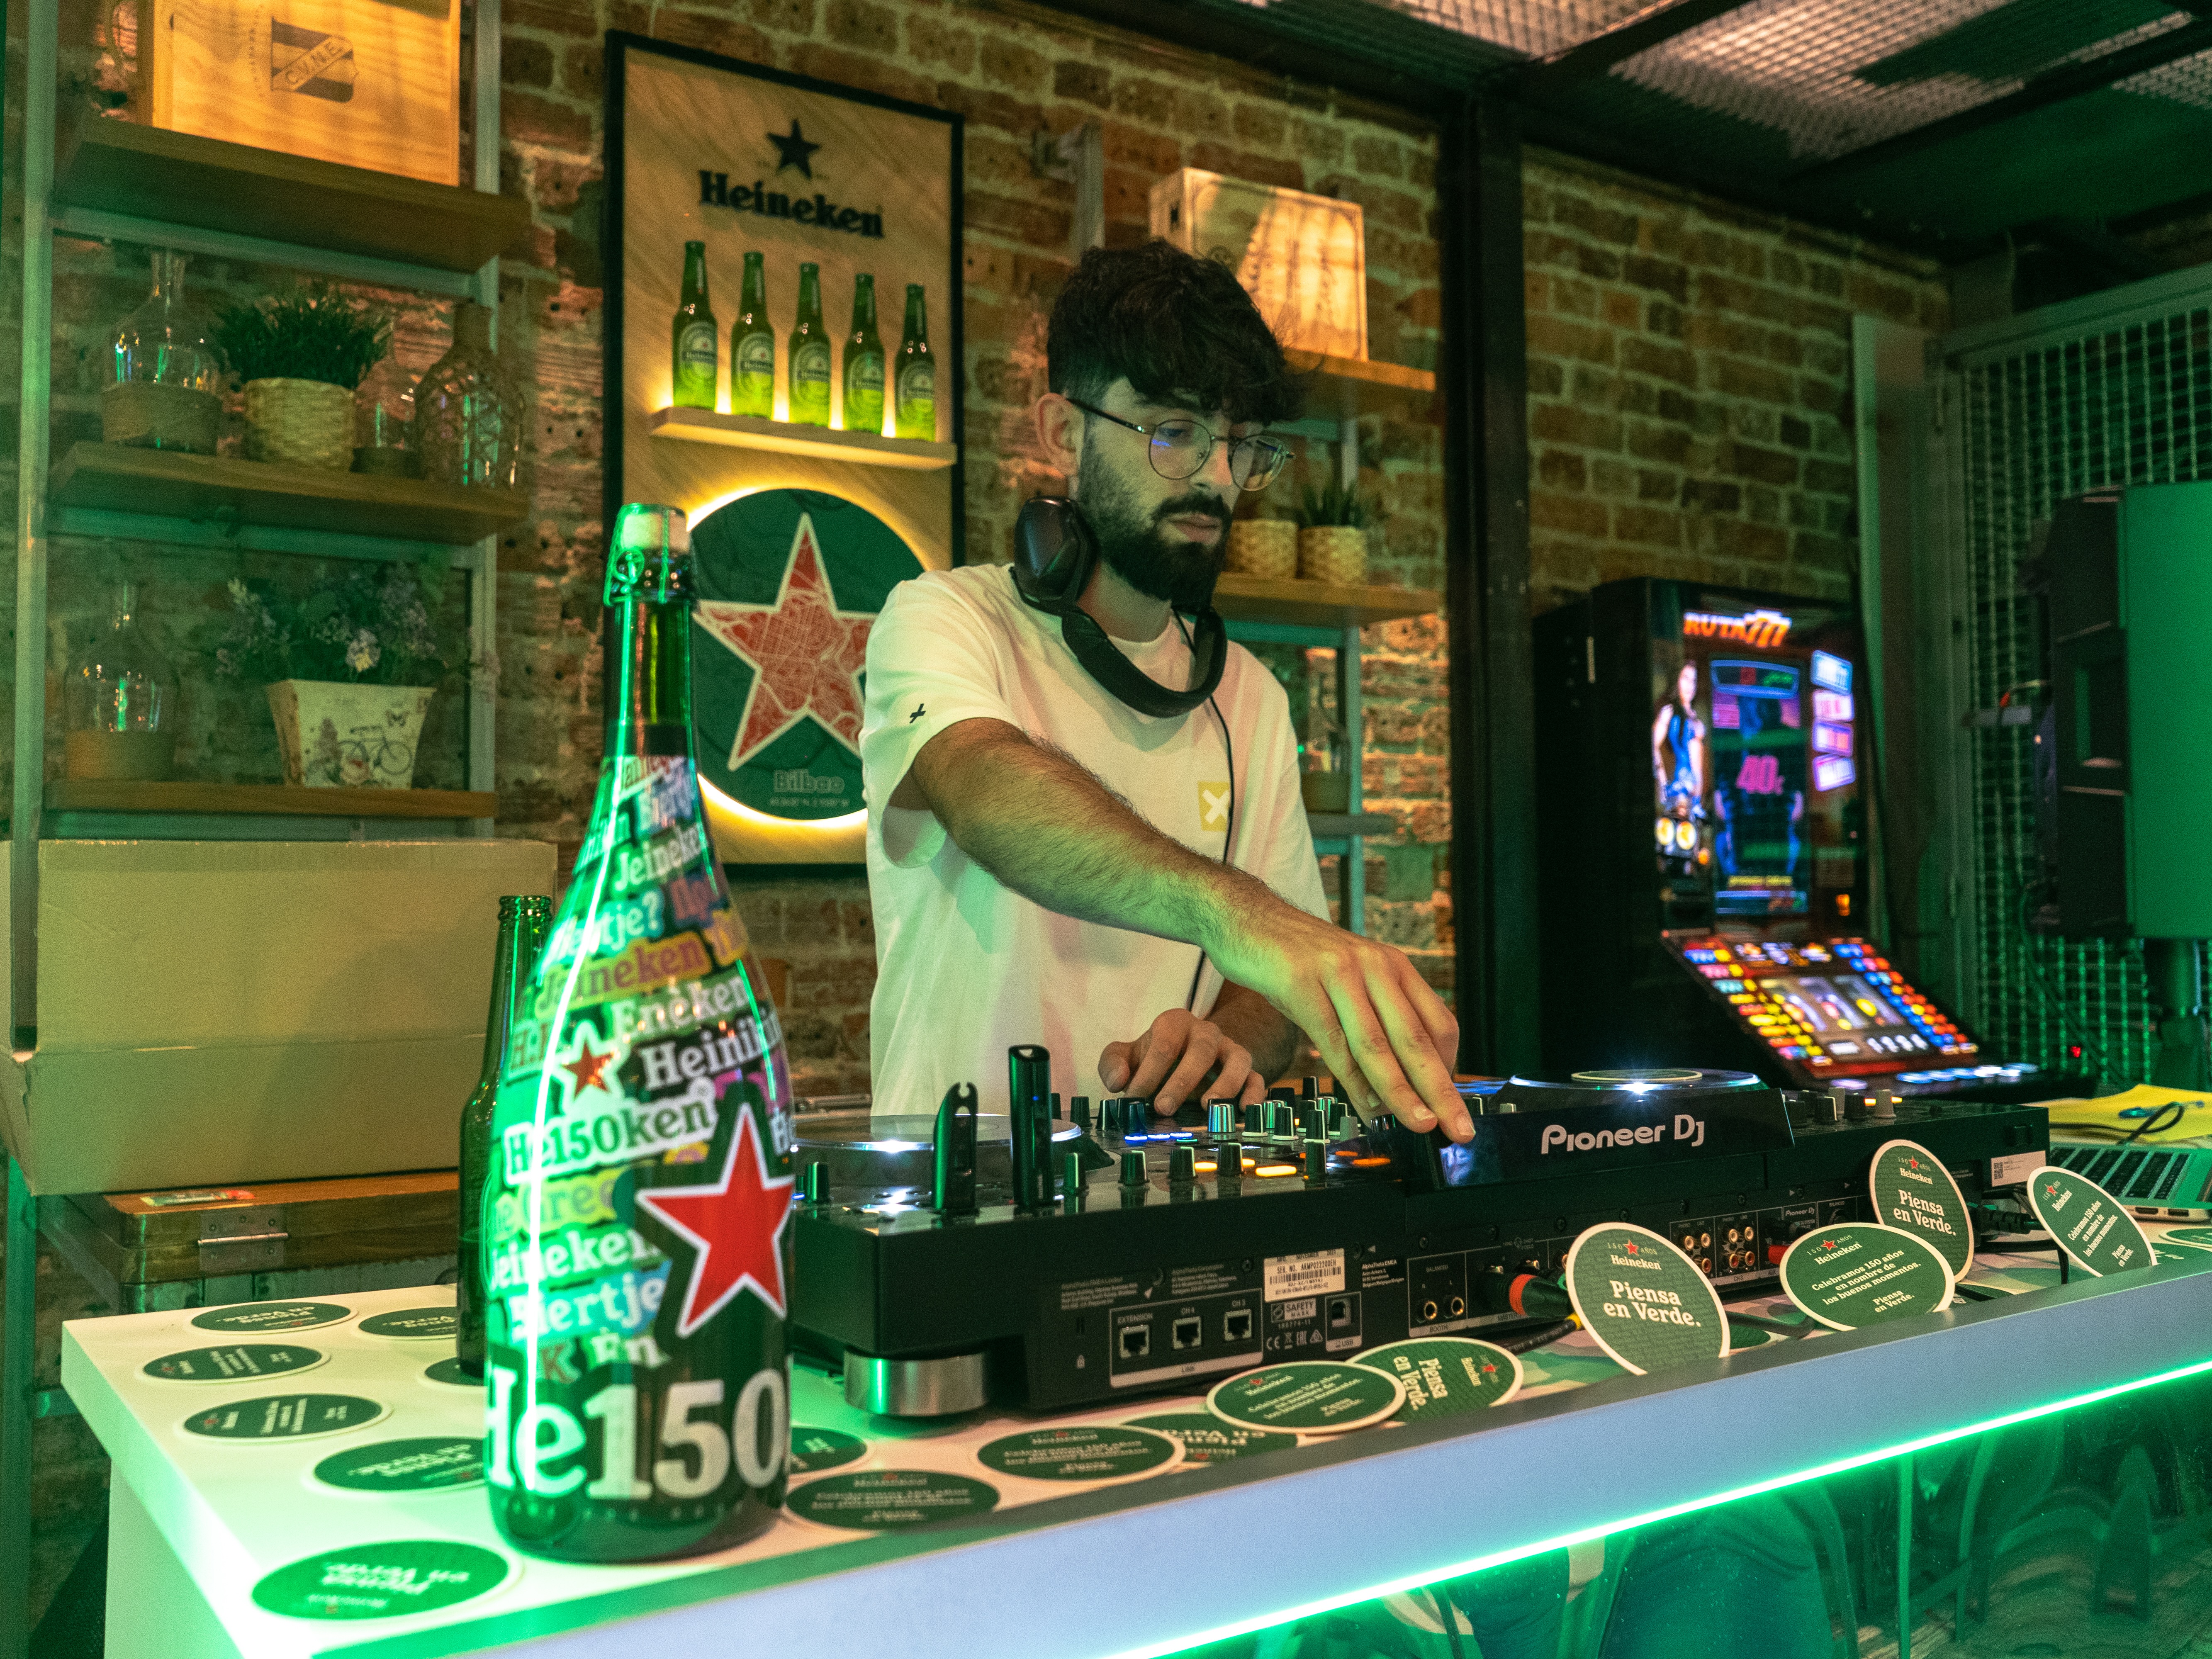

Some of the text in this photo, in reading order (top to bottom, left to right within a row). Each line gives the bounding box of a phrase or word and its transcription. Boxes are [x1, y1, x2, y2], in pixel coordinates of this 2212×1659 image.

[699, 170, 884, 238] Heineken
[1541, 1124, 1665, 1154] Pioneer
[1899, 1168, 1933, 1185] Heineken
[1898, 1189, 1944, 1216] Piensa
[1893, 1208, 1956, 1236] en Verde.
[1641, 1247, 1657, 1255] AÑOS
[1837, 1234, 1852, 1244] AÑOS
[1611, 1254, 1662, 1270] Heineken
[1814, 1242, 1862, 1265] Heineken
[1812, 1249, 1904, 1291] Celebramos 150 años
[1835, 1262, 1896, 1291] en nombre de
[1610, 1280, 1682, 1306] Piensa
[1822, 1262, 1921, 1305] los buenos momentos.
[1286, 1301, 1314, 1311] SAFETY
[1872, 1289, 1904, 1305] Piensa
[1885, 1294, 1915, 1307] Verde.
[1117, 1312, 1153, 1324] EXTENSION
[1604, 1301, 1701, 1327] en Verde.
[1393, 1356, 1411, 1372] en
[1419, 1358, 1448, 1399] Piensa
